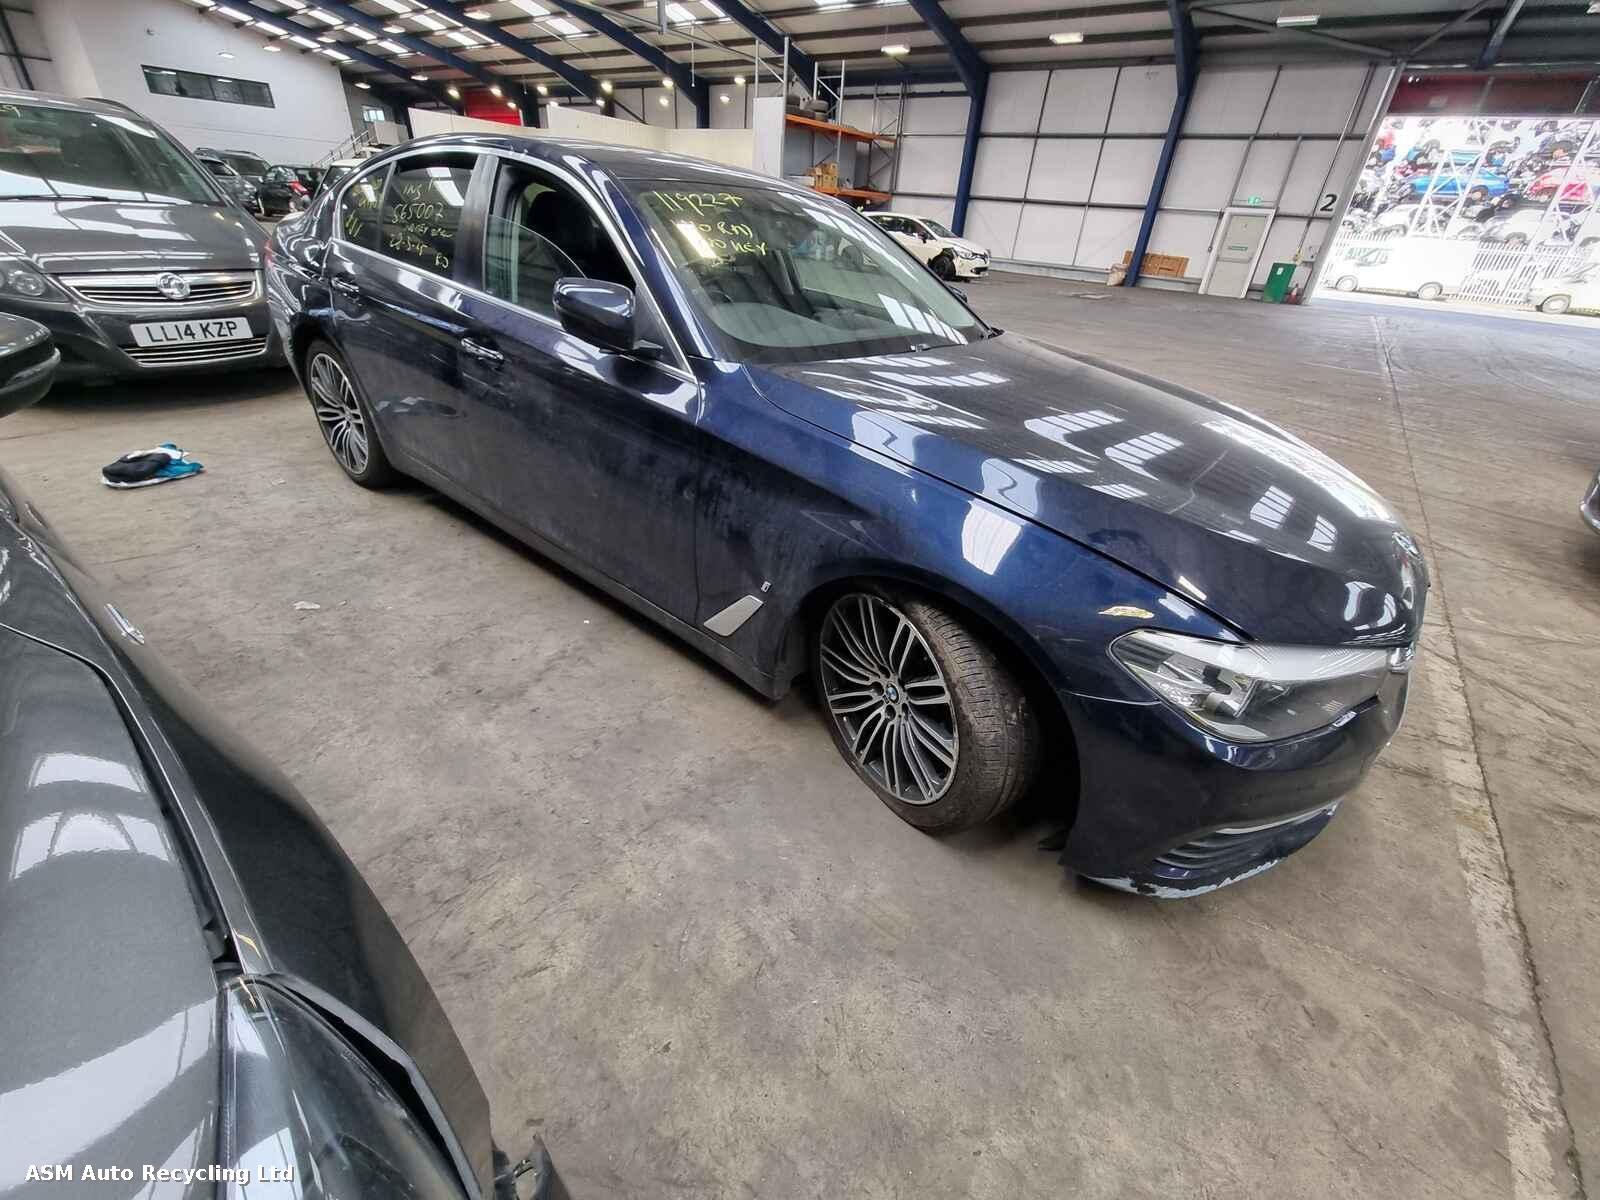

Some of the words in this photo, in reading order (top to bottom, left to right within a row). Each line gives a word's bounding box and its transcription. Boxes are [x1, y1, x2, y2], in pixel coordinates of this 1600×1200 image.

[1320, 194, 1338, 212] 2
[145, 323, 197, 342] LL14
[199, 321, 238, 339] KZP
